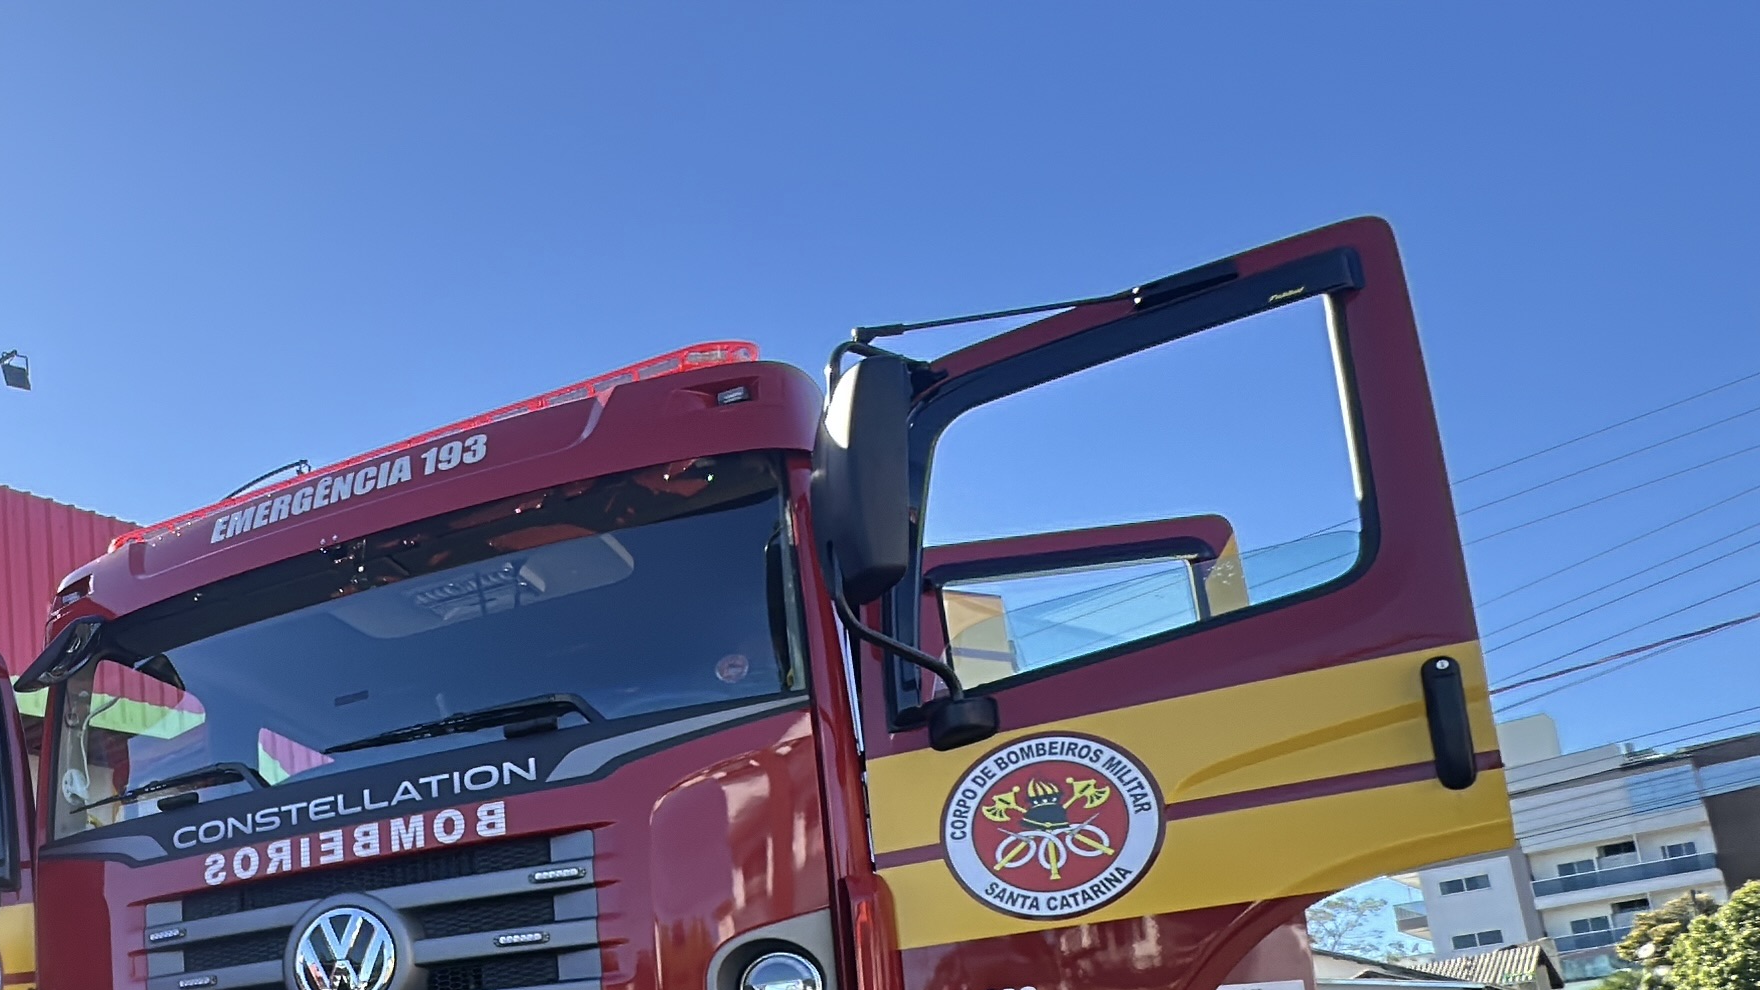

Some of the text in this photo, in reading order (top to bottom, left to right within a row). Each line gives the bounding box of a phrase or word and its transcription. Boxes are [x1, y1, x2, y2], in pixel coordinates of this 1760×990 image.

[209, 433, 488, 545] EMERGÊNCIA 193
[172, 757, 538, 850] CONSTELLATION
[950, 740, 1152, 841] CORPO DE BOMBEIROS MILITAR
[984, 865, 1134, 912] SANTA CATARINA
